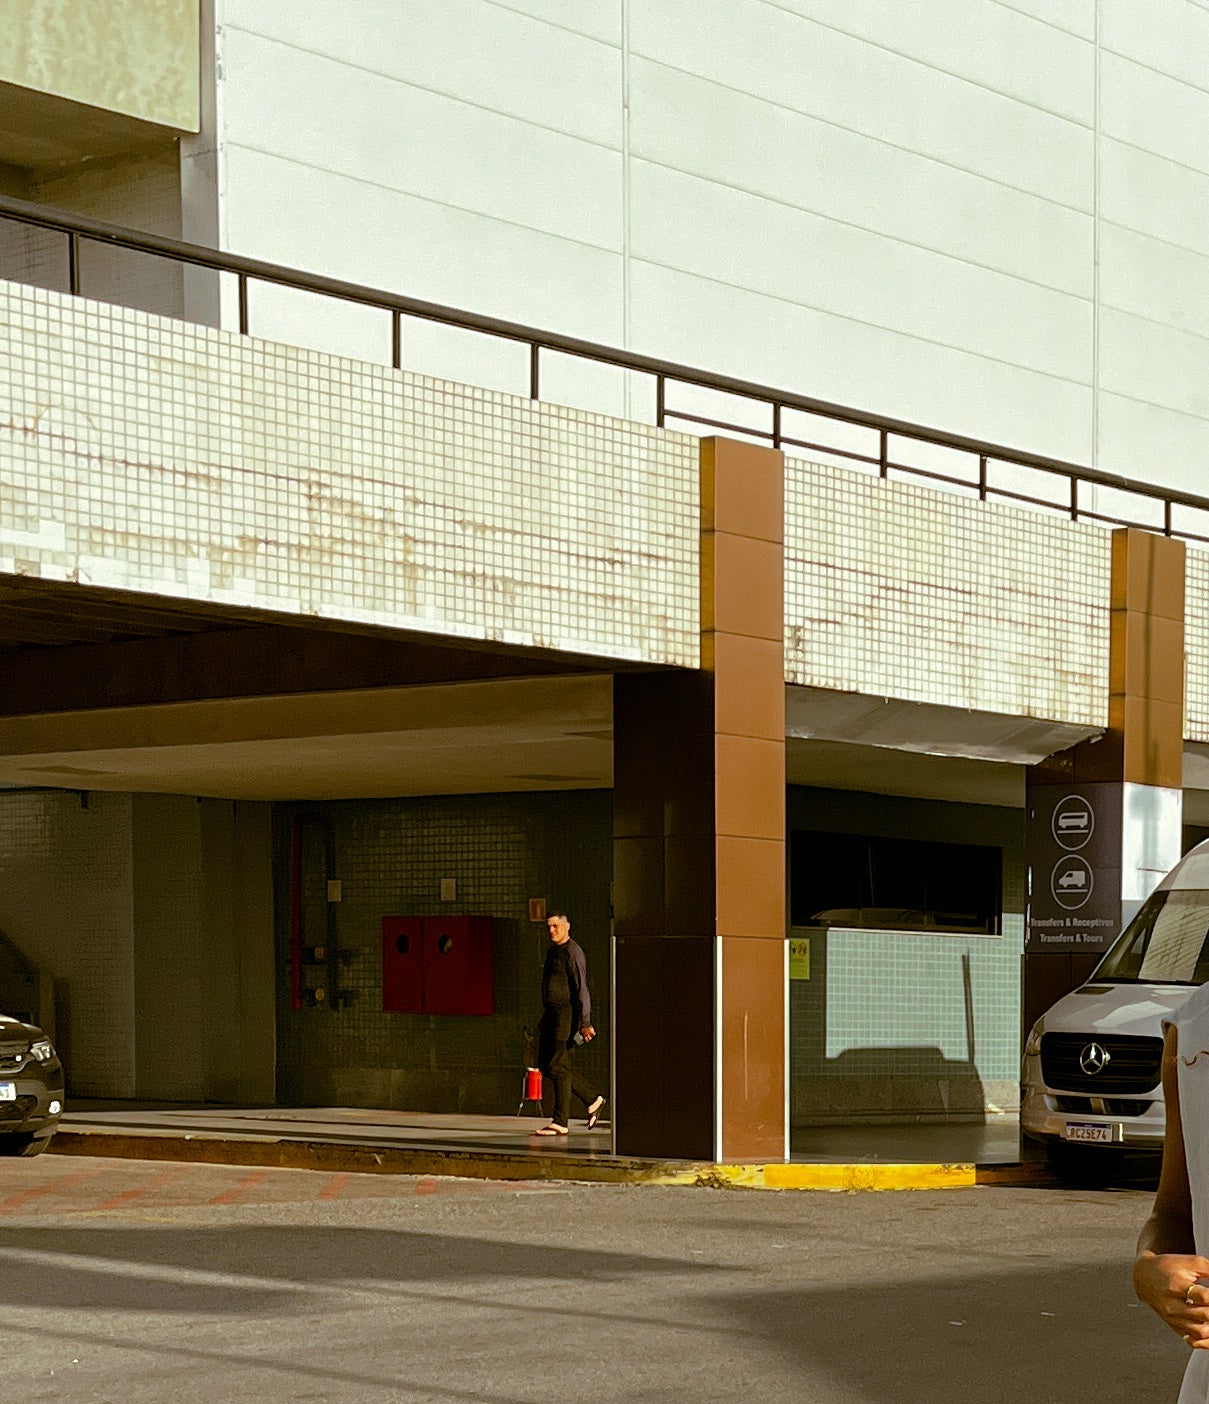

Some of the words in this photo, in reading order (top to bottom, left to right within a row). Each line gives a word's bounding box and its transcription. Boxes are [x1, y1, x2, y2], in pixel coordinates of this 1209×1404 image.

[1031, 917, 1064, 927] Transfers
[1065, 917, 1071, 927] &
[1040, 933, 1074, 943] Transfers
[1075, 933, 1082, 943] &
[1082, 933, 1104, 943] Tours
